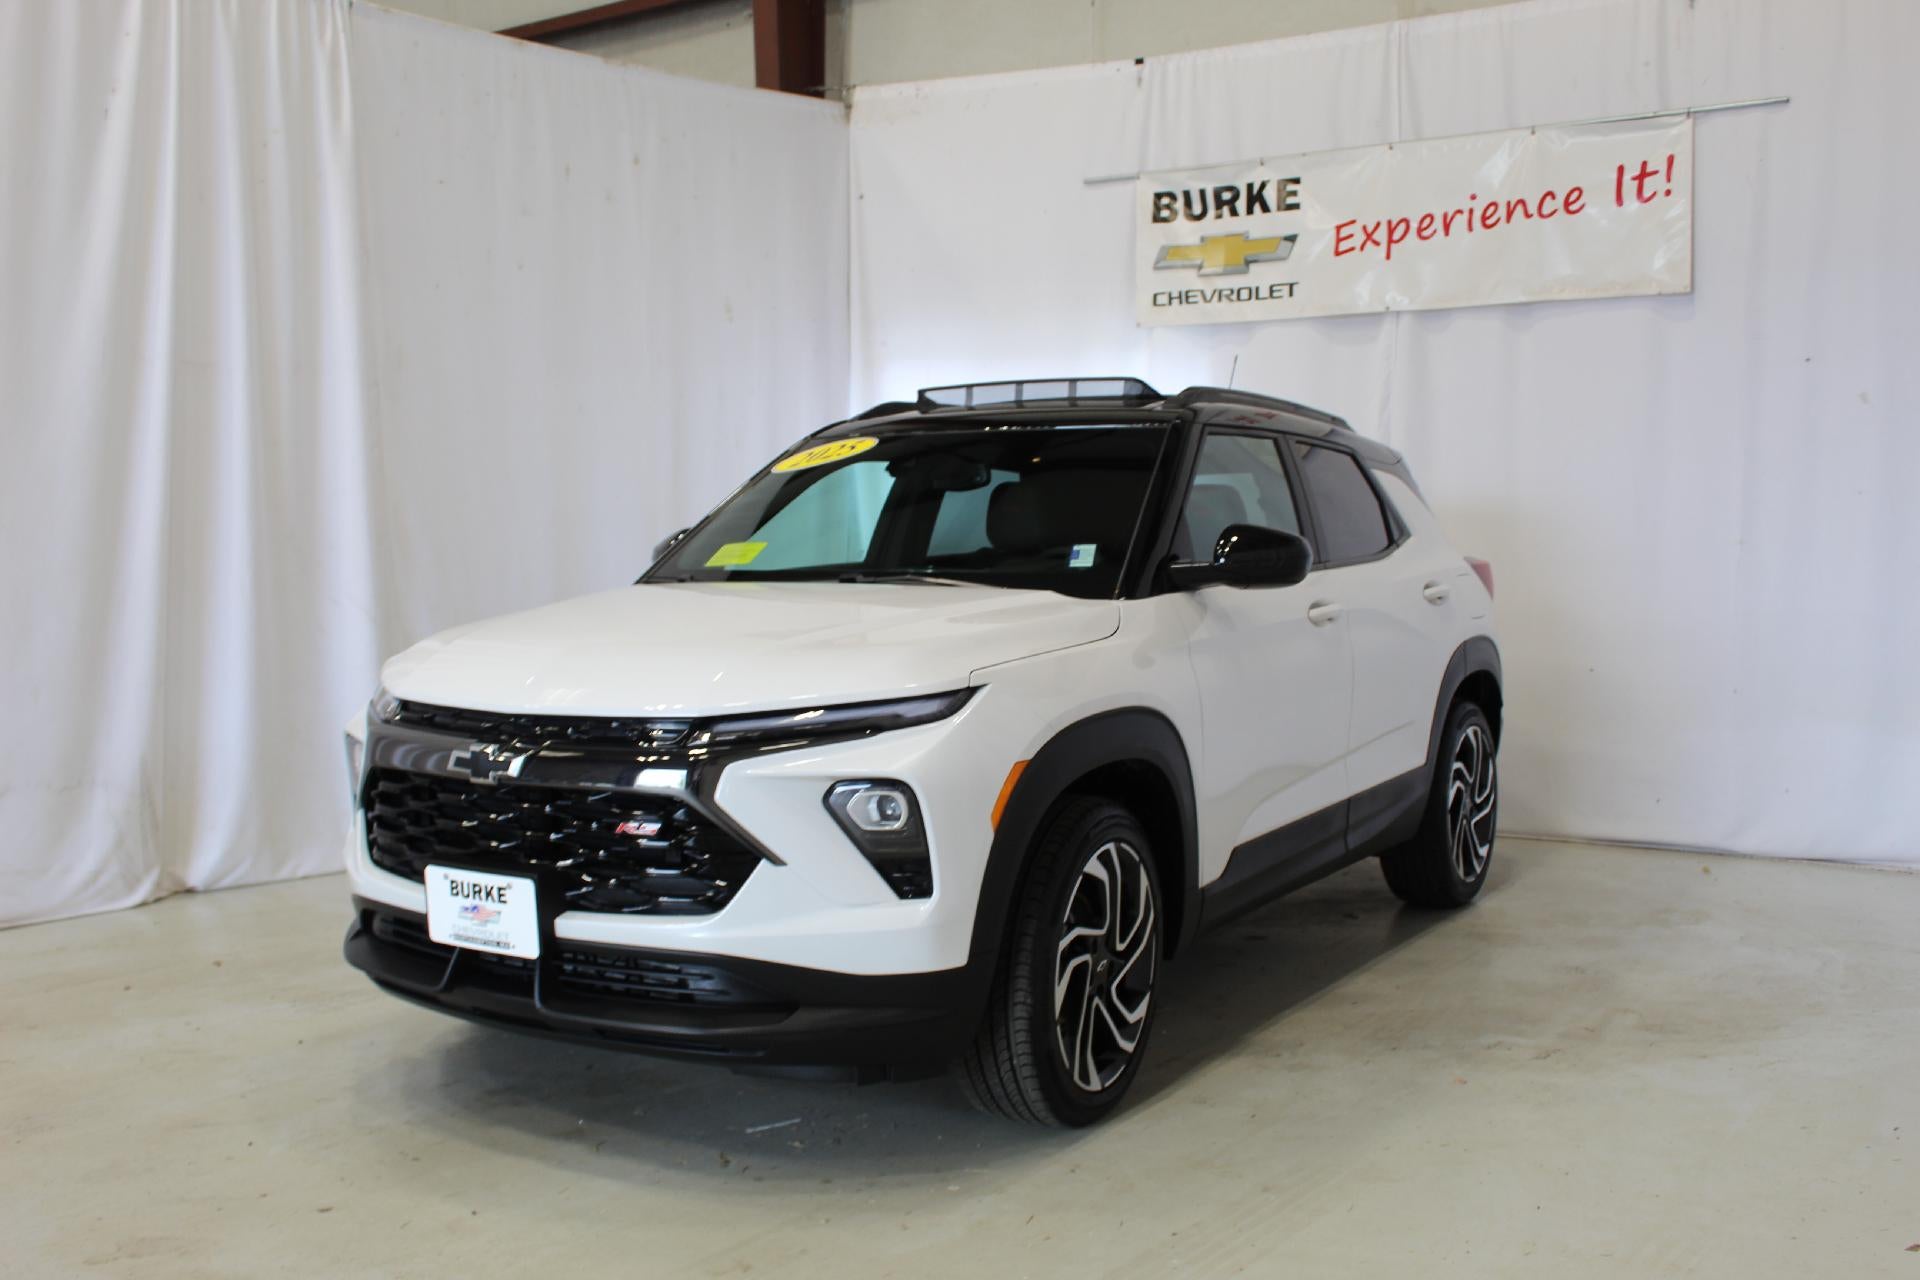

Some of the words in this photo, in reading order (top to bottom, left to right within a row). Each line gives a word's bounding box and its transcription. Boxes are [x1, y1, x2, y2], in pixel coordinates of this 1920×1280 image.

[1152, 176, 1302, 224] BURKE
[1333, 185, 1586, 261] Experience
[1614, 153, 1676, 208] It!
[1152, 281, 1300, 307] CHEVROLET
[449, 879, 508, 904] BURKE
